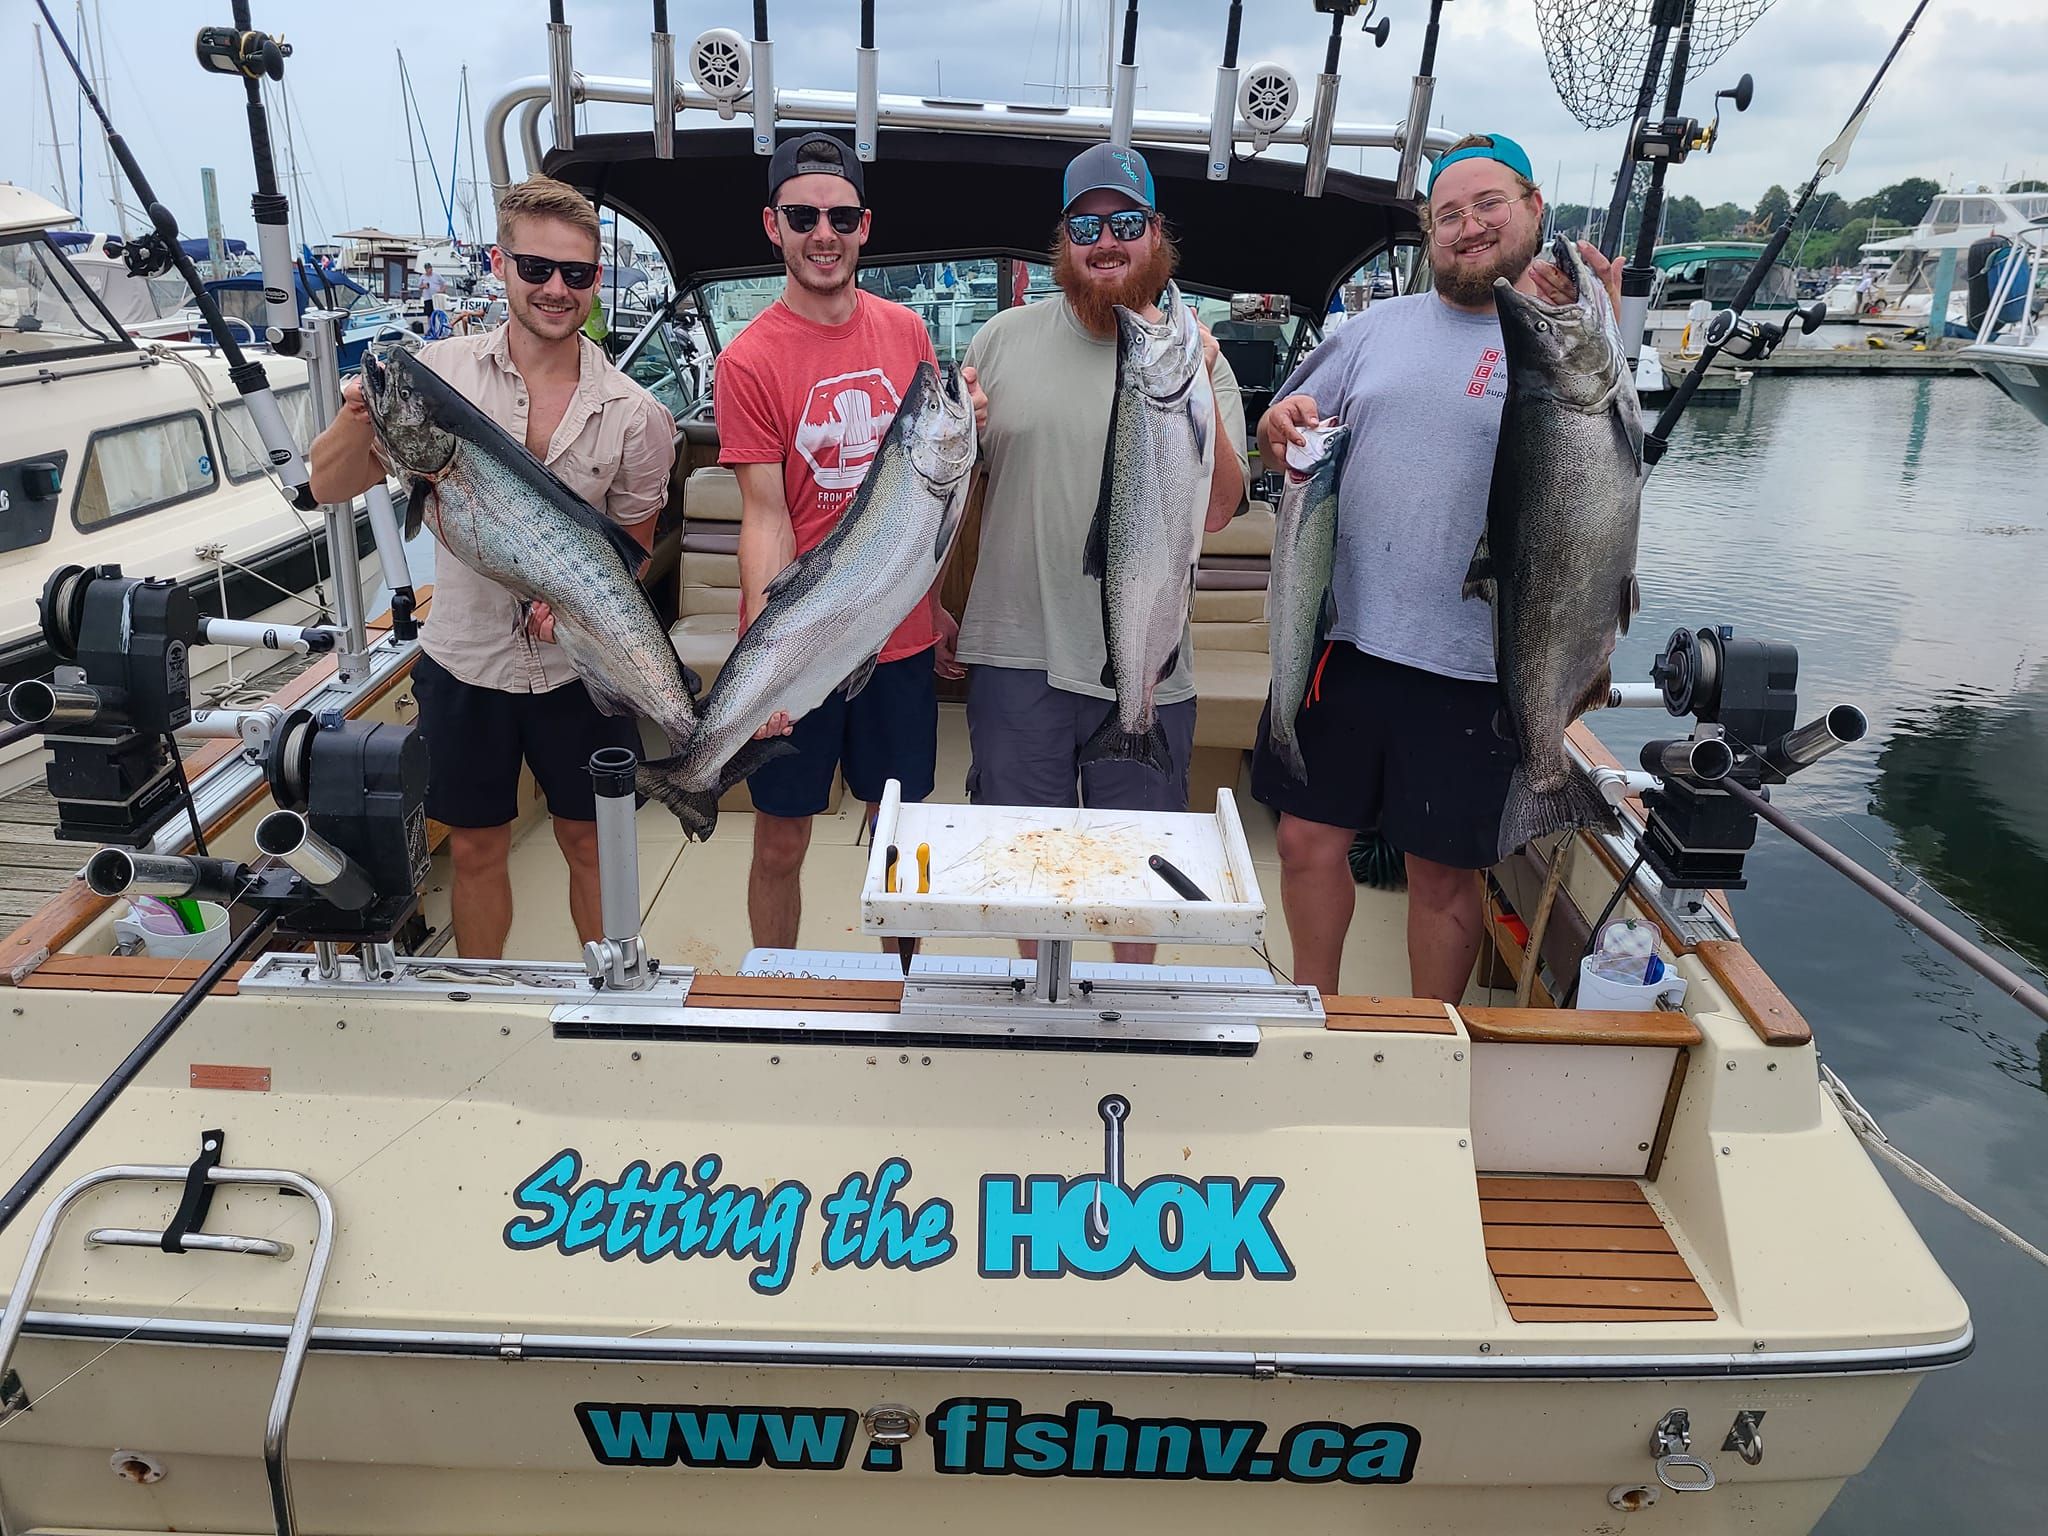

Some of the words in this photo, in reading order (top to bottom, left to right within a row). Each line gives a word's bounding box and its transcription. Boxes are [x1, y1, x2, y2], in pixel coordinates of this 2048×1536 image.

[0, 490, 10, 511] 6
[818, 491, 842, 502] FROM
[507, 1152, 808, 1291] Setting
[826, 1160, 953, 1267] the
[982, 1176, 1292, 1277] HOOK
